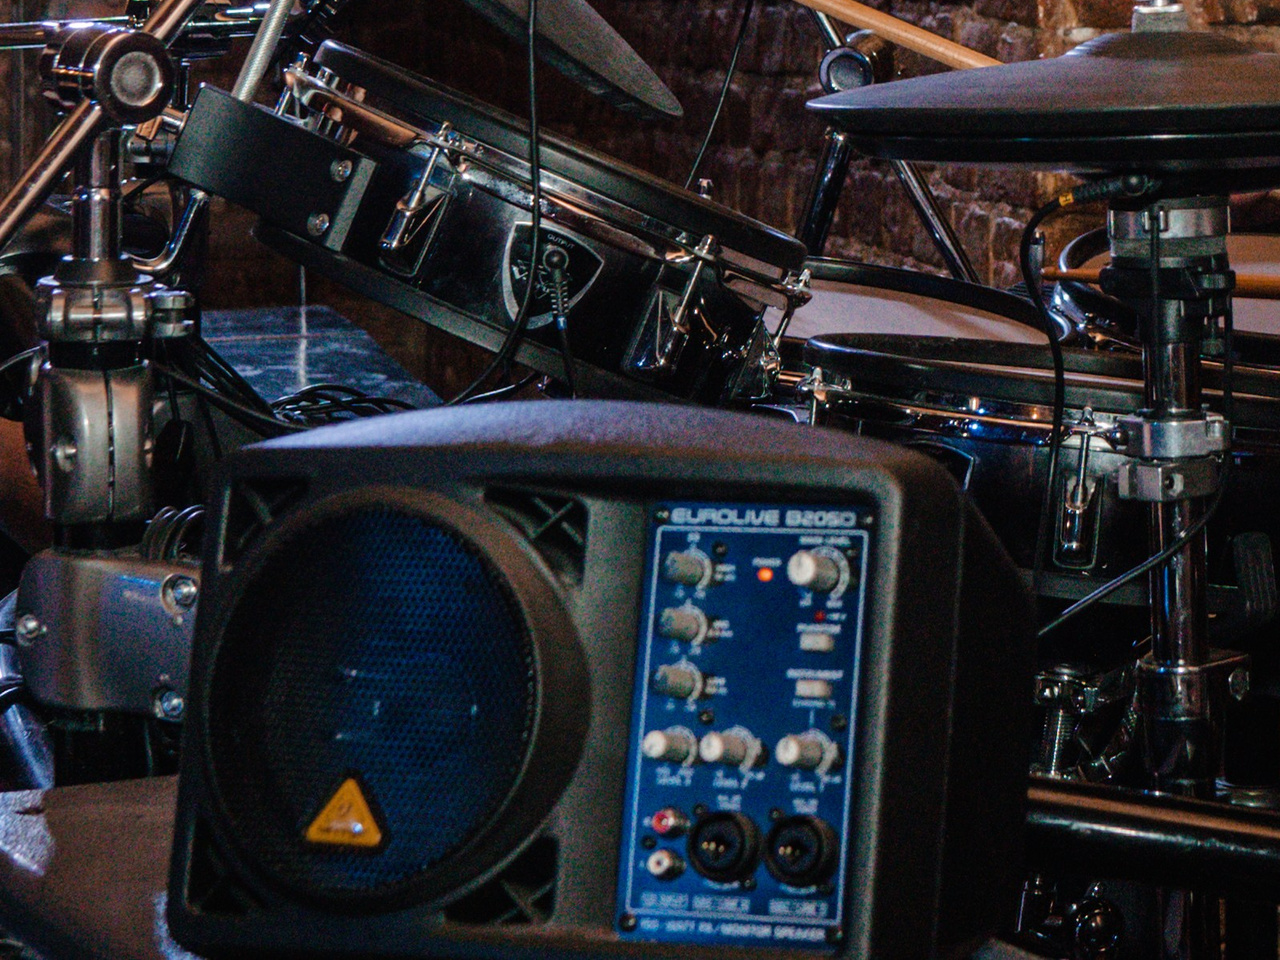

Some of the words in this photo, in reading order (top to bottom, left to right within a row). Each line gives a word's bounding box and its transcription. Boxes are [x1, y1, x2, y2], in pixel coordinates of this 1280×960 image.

[547, 233, 575, 250] OUTPUT
[671, 508, 779, 525] EUROLIVE
[786, 510, 856, 527] B205D
